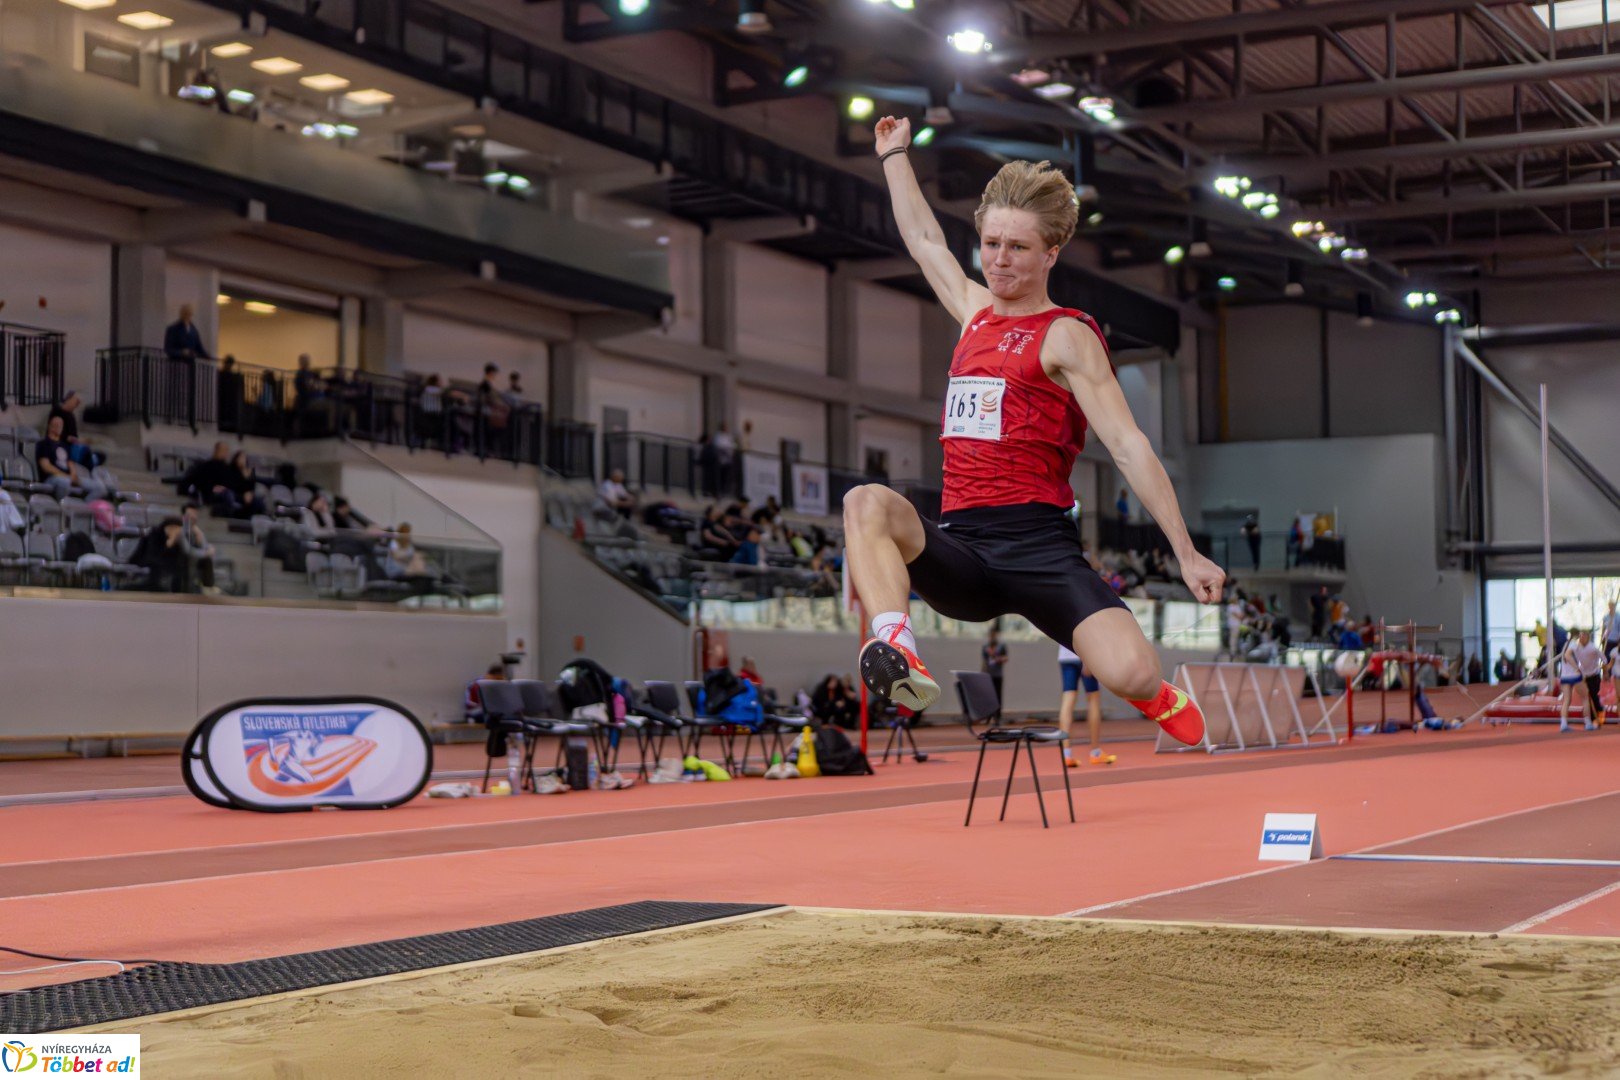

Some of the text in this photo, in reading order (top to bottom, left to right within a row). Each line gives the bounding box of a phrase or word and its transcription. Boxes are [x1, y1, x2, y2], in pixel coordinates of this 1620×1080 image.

[948, 392, 977, 418] 165
[243, 714, 300, 731] SLOVENSKÁ
[302, 714, 348, 729] ATLETIKA
